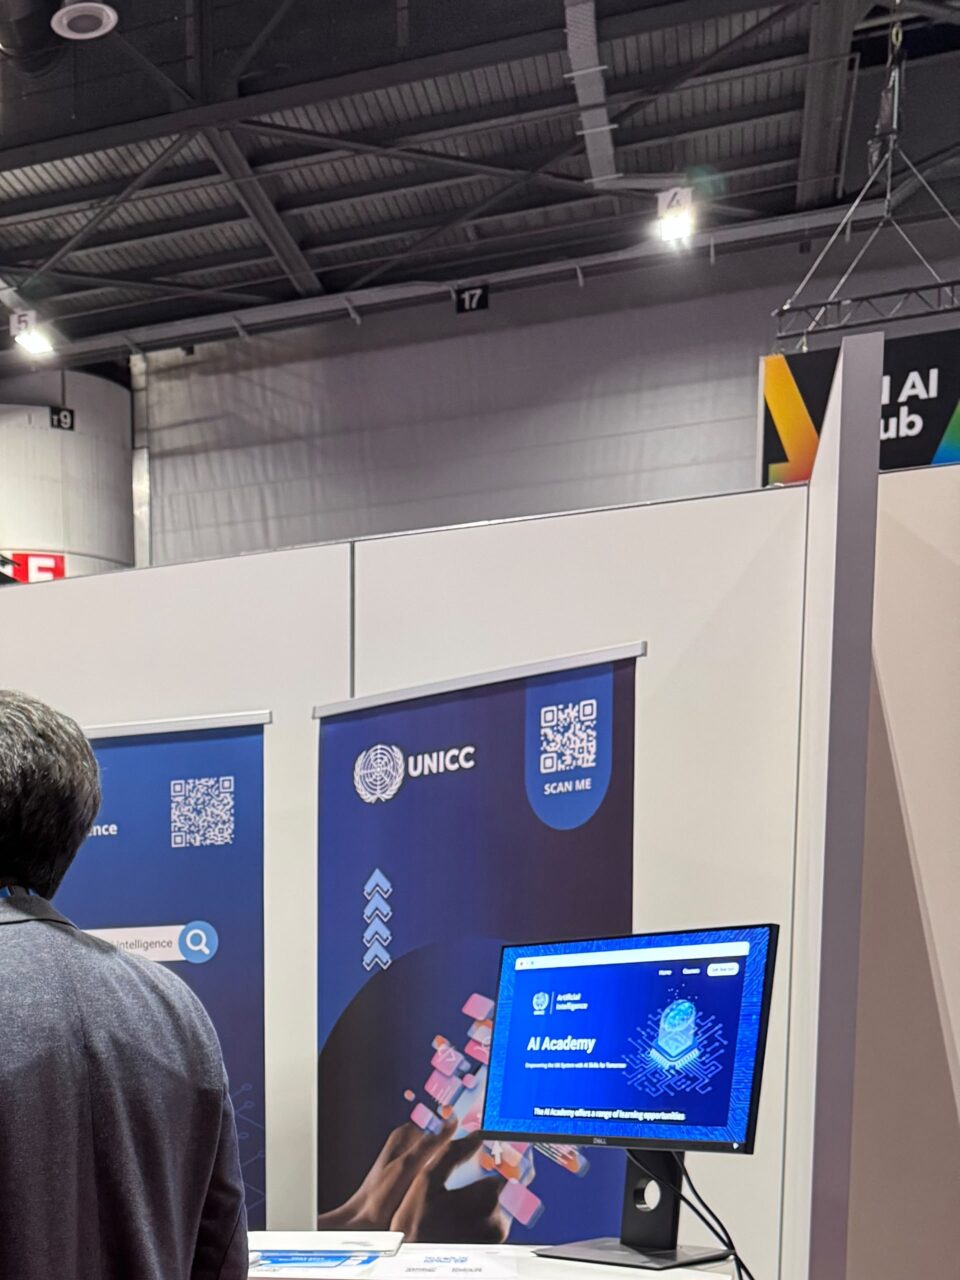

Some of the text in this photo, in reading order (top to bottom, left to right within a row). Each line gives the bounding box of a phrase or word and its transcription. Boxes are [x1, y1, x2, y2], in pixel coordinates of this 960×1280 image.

[461, 288, 483, 310] 17
[17, 313, 29, 331] 5
[897, 367, 939, 403] AI
[880, 405, 924, 441] ub
[408, 746, 476, 777] UNICC
[543, 778, 592, 796] SCAN ME
[89, 823, 118, 836] nce
[527, 1035, 596, 1054] AI Academy
[534, 1107, 544, 1116] The
[544, 1107, 550, 1116] AI
[550, 1107, 575, 1119] Academy
[574, 1108, 591, 1118] offers
[595, 1110, 612, 1120] range
[619, 1109, 644, 1121] learning
[643, 1111, 686, 1121] opportunities
